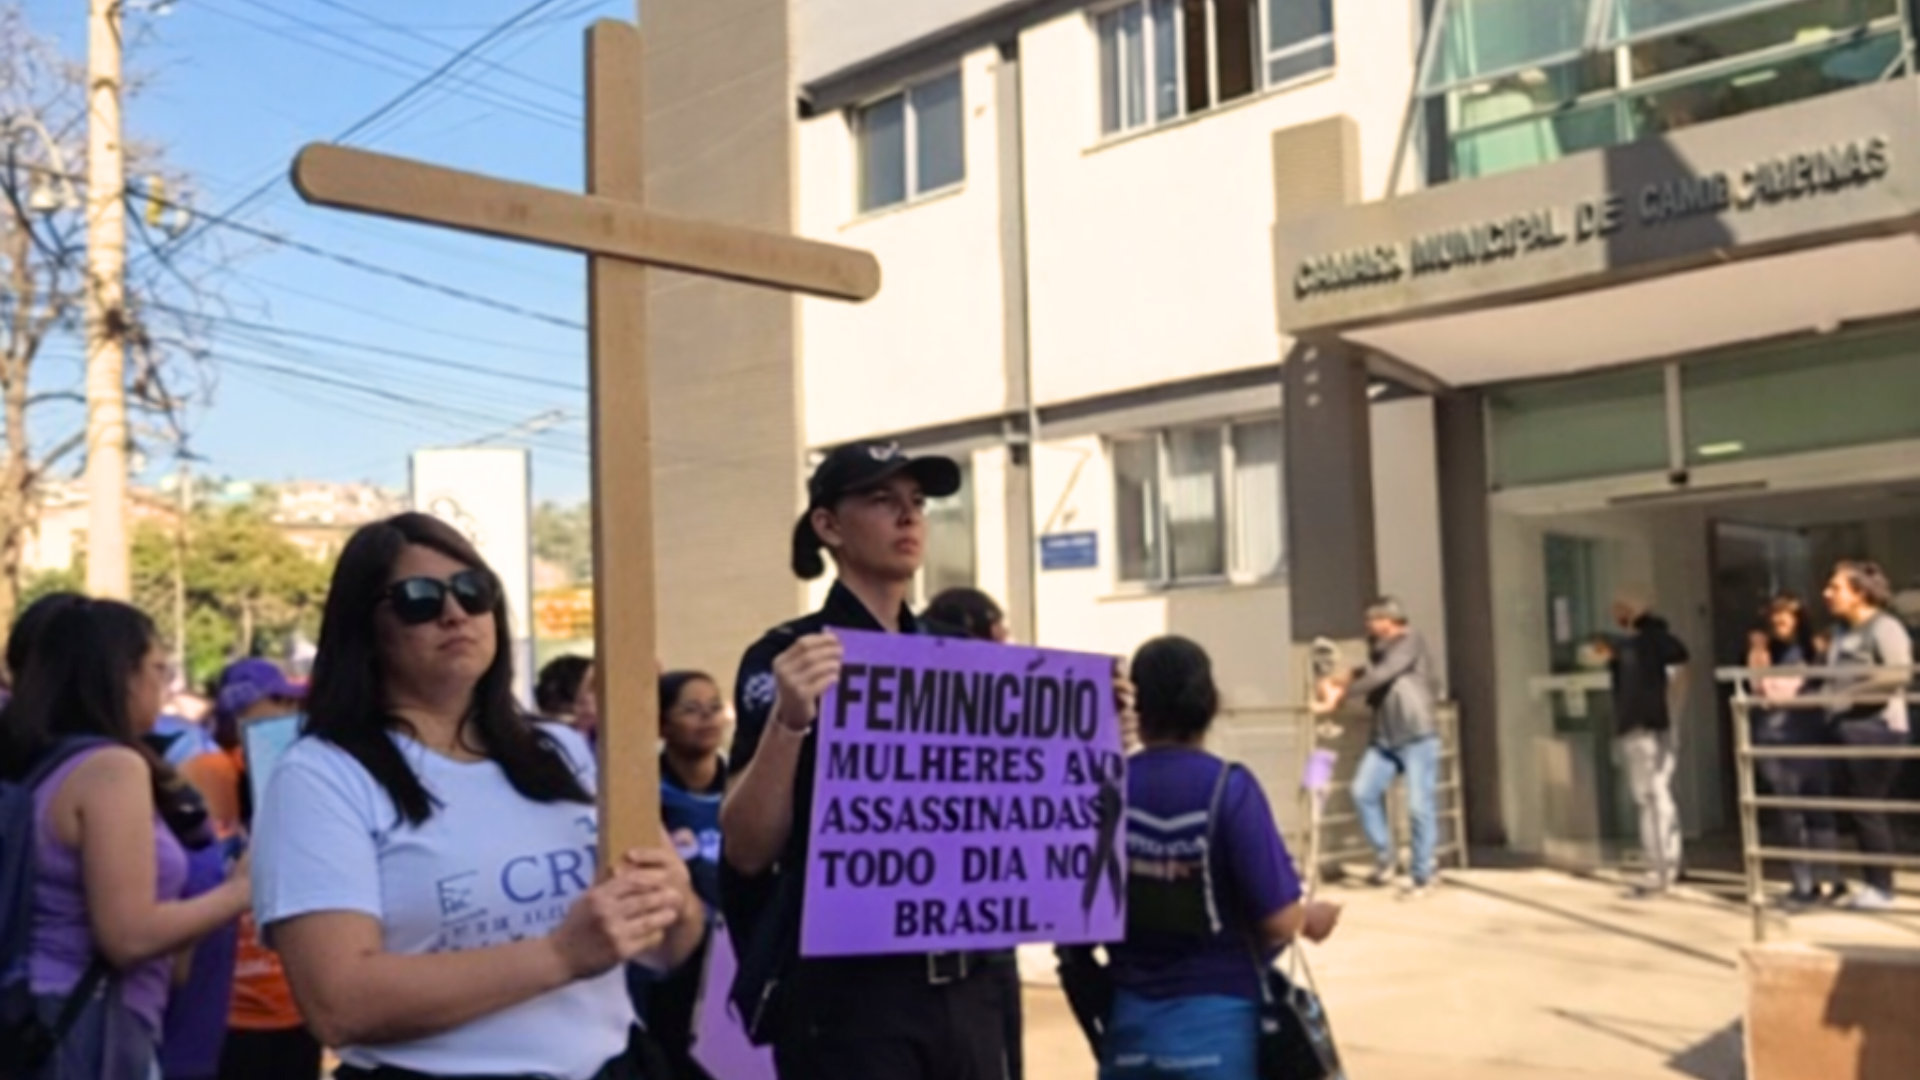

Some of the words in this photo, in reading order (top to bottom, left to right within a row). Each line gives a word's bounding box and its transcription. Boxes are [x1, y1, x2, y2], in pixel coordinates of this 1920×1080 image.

[826, 742, 1045, 784] MULHERES
[819, 848, 937, 889] TODO
[961, 846, 1028, 884] DIA
[1045, 842, 1092, 881] NO
